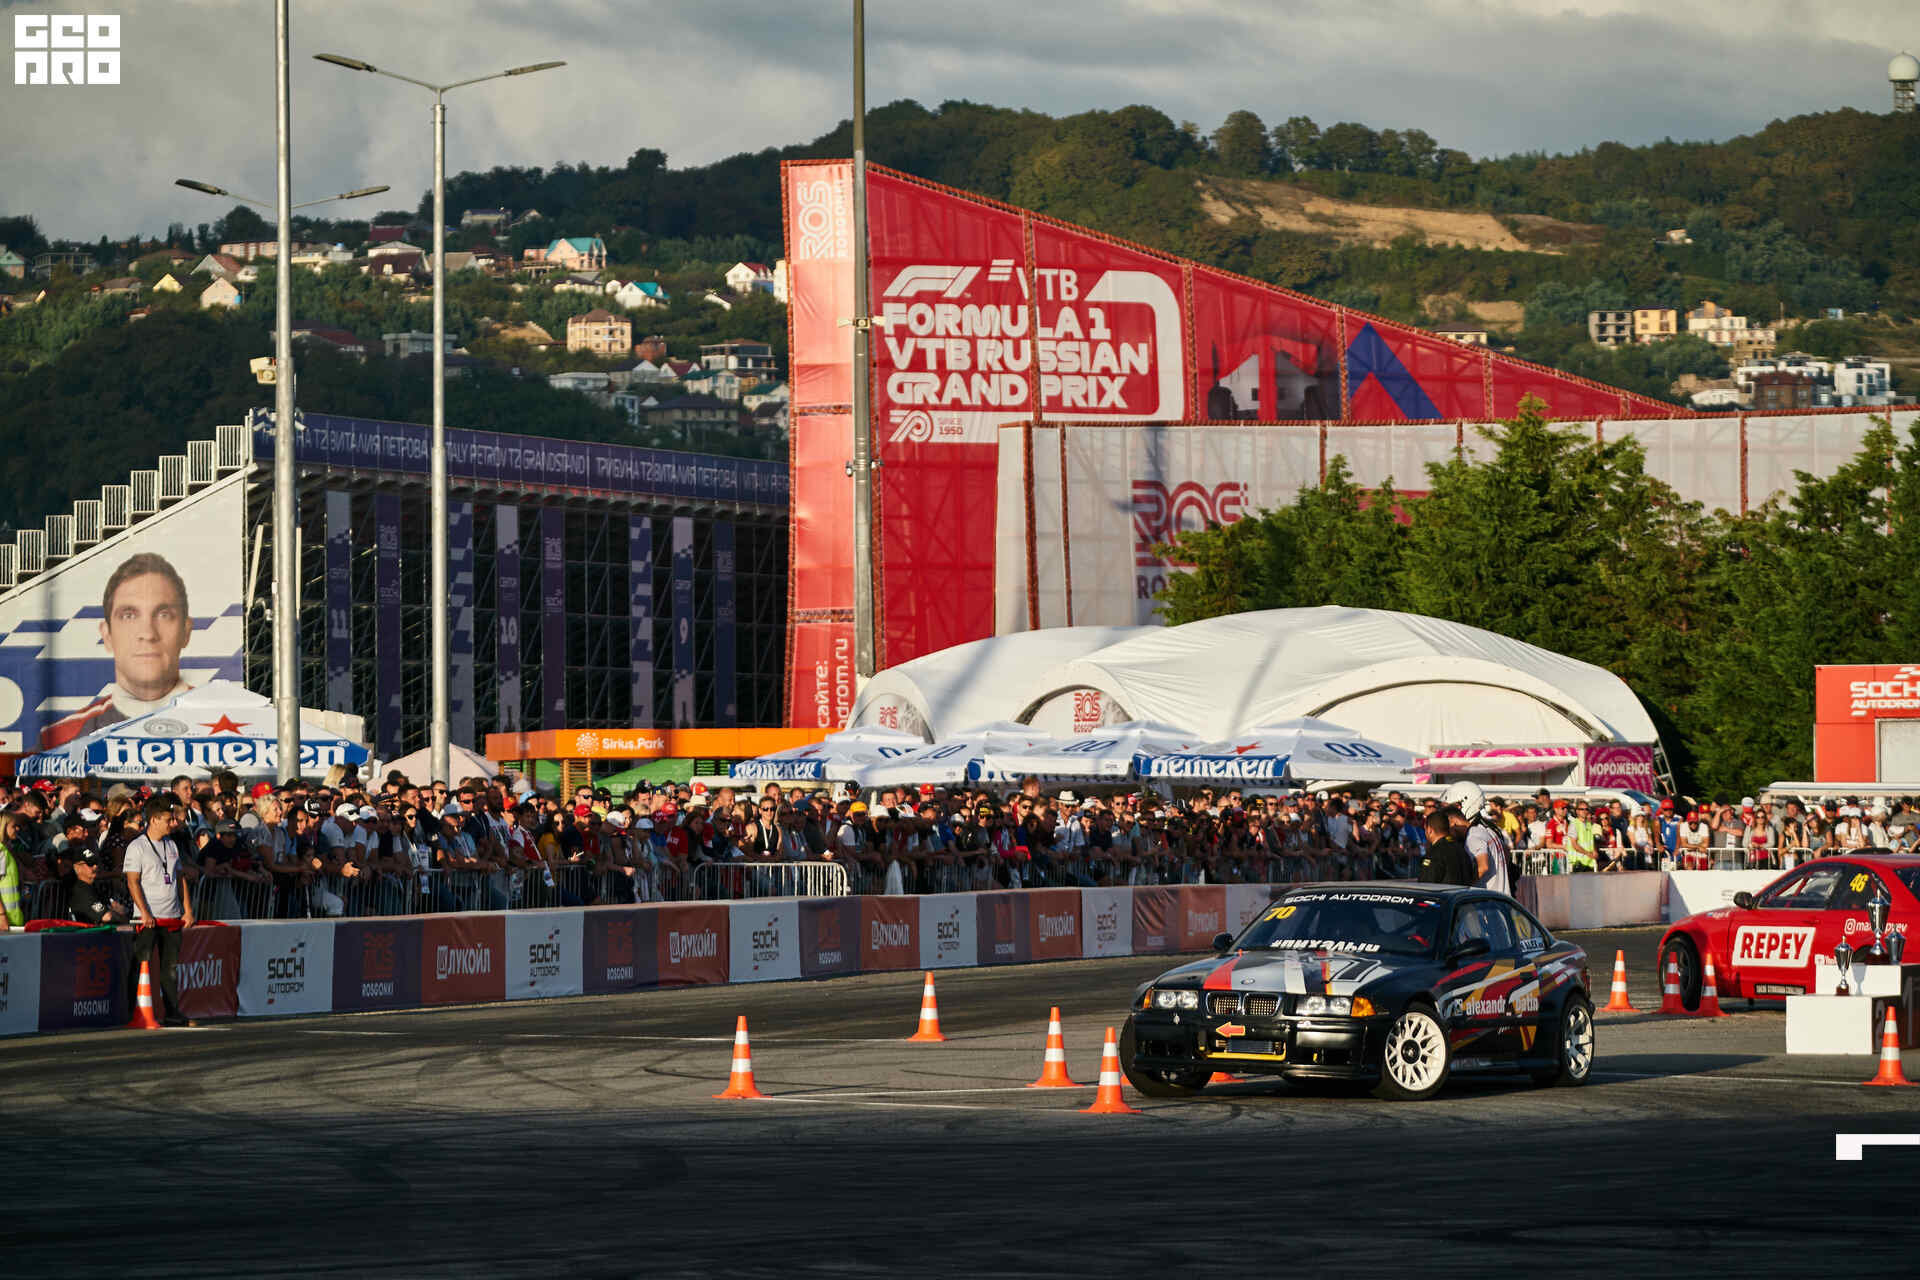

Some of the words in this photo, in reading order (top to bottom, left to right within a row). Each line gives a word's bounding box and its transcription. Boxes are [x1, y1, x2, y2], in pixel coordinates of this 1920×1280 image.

[882, 302, 1083, 341] FORMULA
[1088, 307, 1111, 341] 1
[883, 336, 971, 371] VTB
[978, 340, 1150, 376] RUSSIAN
[886, 371, 1030, 406] GRAND
[1041, 376, 1128, 409] PRIX
[501, 616, 517, 645] 10
[679, 616, 689, 645] 9
[1850, 699, 1920, 709] AUTODRO
[105, 737, 346, 769] Heineken
[1589, 762, 1651, 776] МОРОЖЕНОЕ
[1850, 872, 1870, 893] 46
[1283, 893, 1326, 905] SOCHI
[1329, 893, 1415, 905] AUTODROM
[1263, 905, 1297, 922] 70
[679, 928, 718, 959] ЛУКОЙЛ
[752, 930, 780, 949] SOCHI
[878, 919, 911, 947] ЛУКОЙЛ
[1740, 932, 1809, 959] REPEY
[447, 942, 491, 977] ЛУКОЙЛ
[529, 943, 561, 964] SOCHI
[267, 957, 305, 979] SOCHI
[73, 1000, 110, 1017] ROSGONKI
